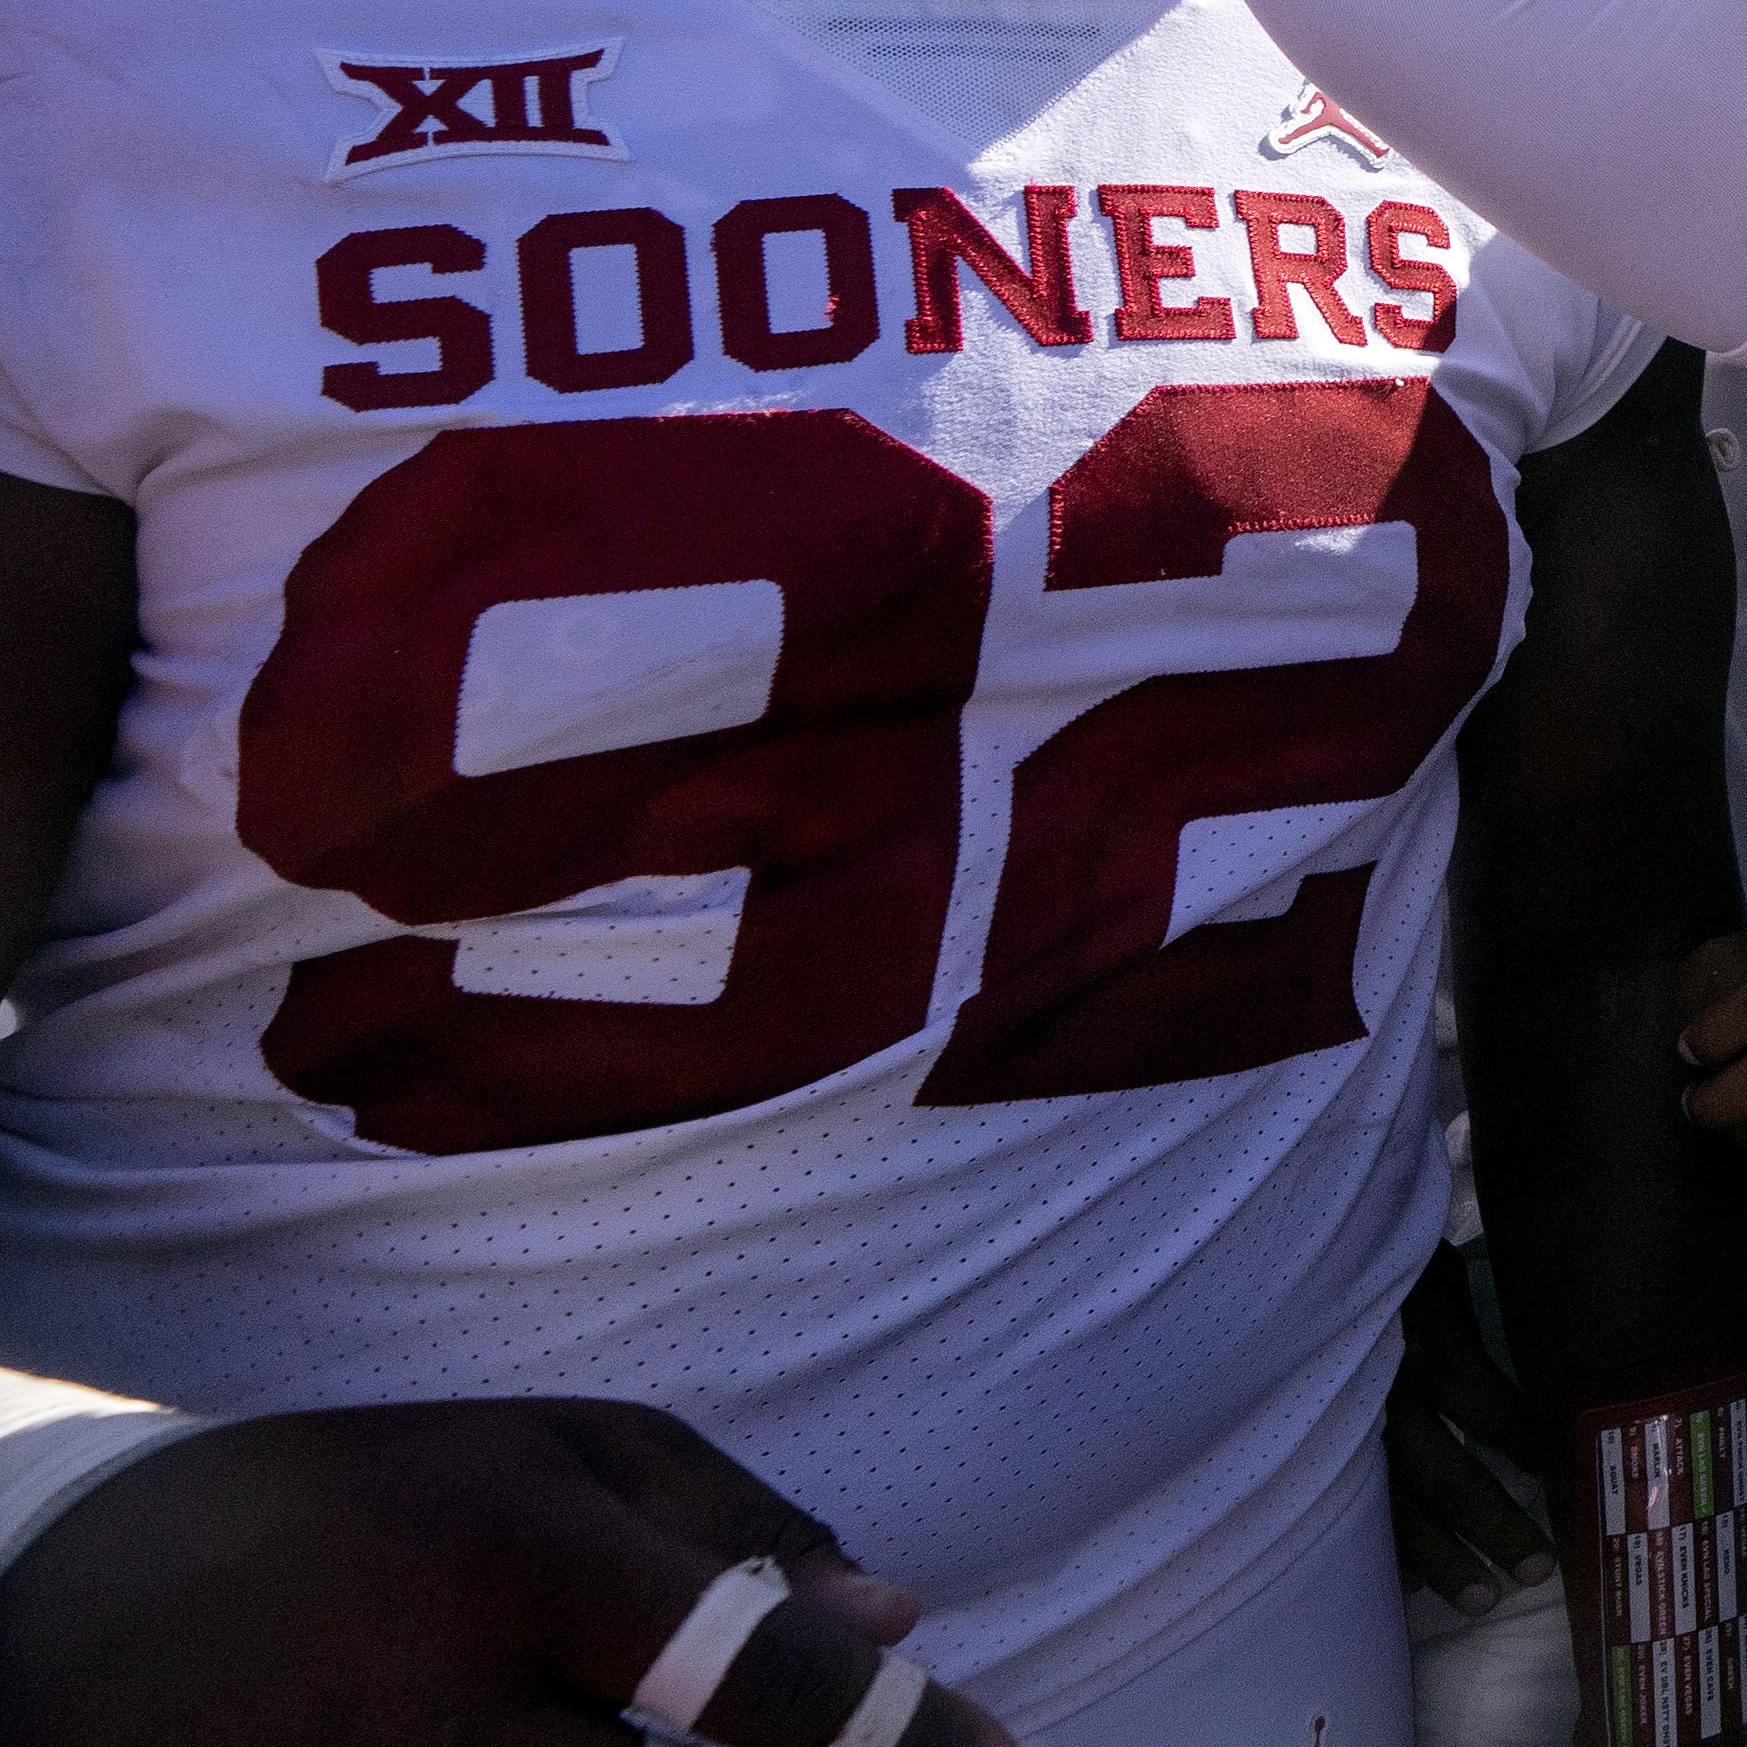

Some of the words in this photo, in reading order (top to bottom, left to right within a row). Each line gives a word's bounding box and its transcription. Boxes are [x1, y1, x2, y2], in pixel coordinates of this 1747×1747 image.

[316, 184, 1458, 413] SOONERS
[236, 378, 1511, 1158] 92
[1675, 1438, 1684, 1475] ATTACK
[1610, 1465, 1618, 1495] SQUAT
[1614, 1556, 1622, 1588] STUNT
[1680, 1546, 1688, 1571] EVEN
[1682, 1573, 1690, 1608] KNICKS
[1658, 1603, 1667, 1635] GREEN
[1638, 1665, 1646, 1690] EVEN
[1683, 1655, 1692, 1681] EVEN
[1684, 1683, 1693, 1715] VEGAS
